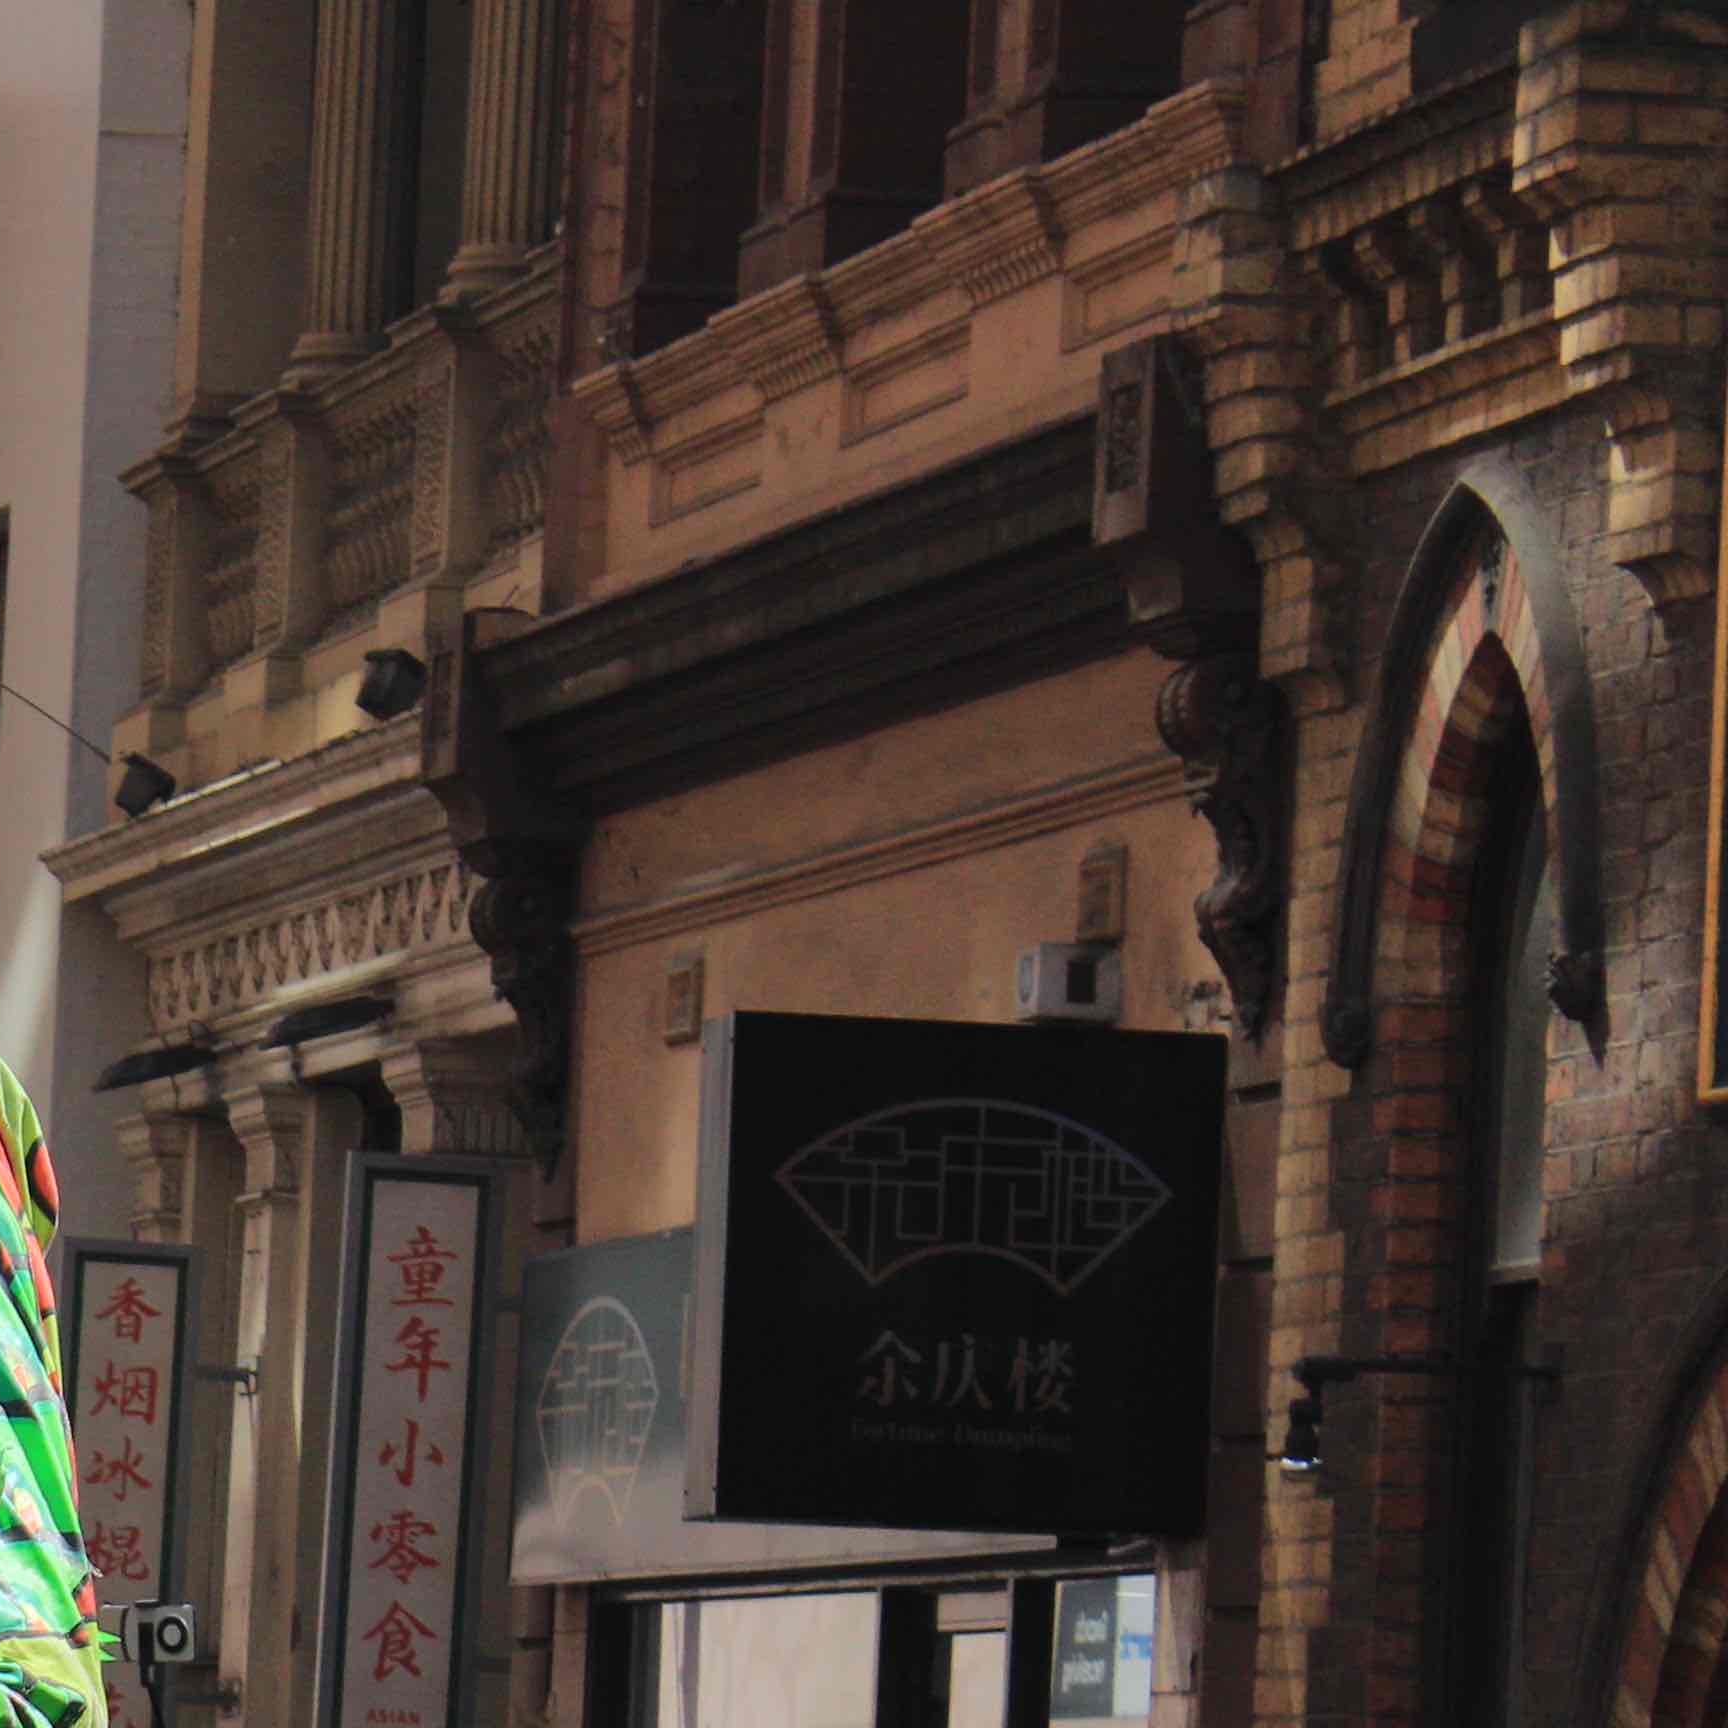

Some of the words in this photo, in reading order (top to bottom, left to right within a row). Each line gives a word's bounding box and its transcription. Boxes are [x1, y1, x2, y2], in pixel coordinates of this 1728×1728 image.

[362, 1224, 460, 1683] 童年小零食
[367, 1708, 420, 1725] ASIAN
